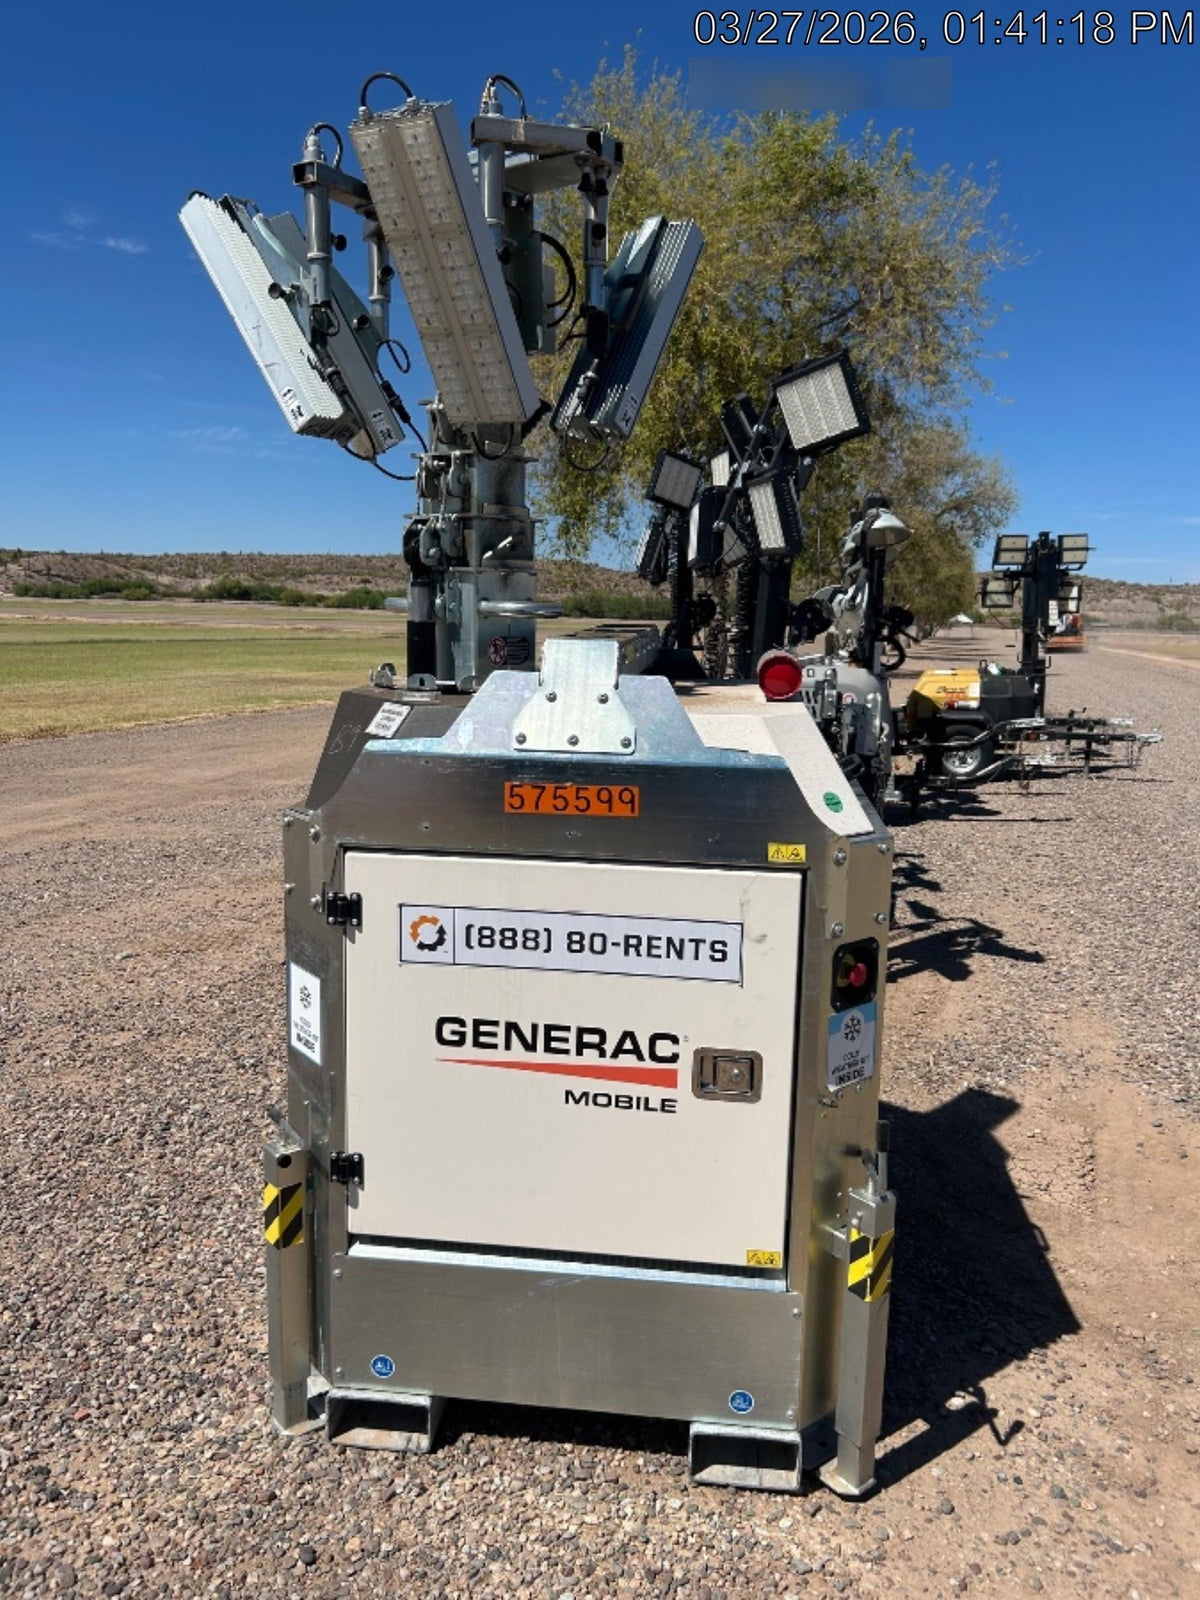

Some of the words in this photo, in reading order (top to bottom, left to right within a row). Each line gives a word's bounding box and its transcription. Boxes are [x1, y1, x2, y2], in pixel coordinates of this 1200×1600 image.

[507, 783, 638, 814] 575599
[464, 923, 552, 953] (888)
[566, 930, 729, 962] 80-RENTS
[435, 1016, 680, 1064] GENERAC
[564, 1089, 678, 1114] MOBILE
